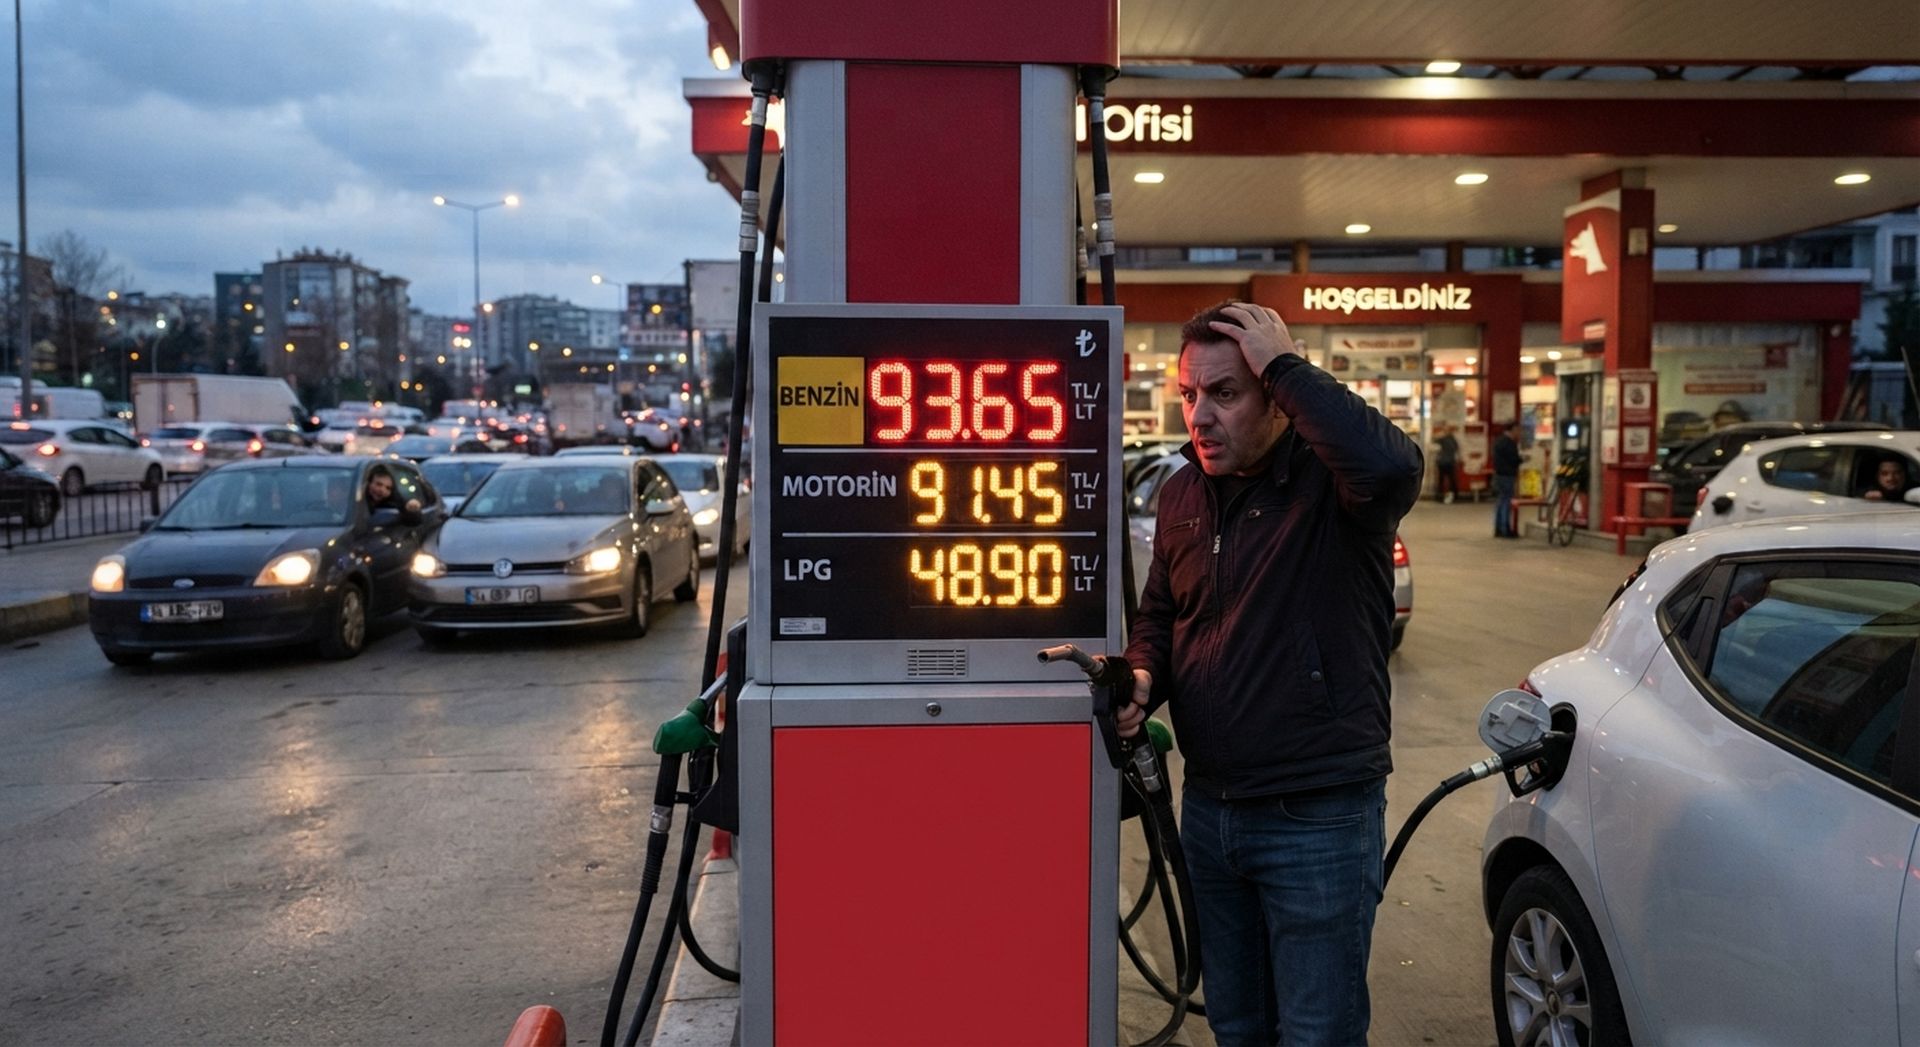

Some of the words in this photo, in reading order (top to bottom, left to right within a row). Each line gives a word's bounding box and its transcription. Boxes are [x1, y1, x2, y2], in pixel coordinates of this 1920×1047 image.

[1103, 105, 1192, 141] Ofisi
[1304, 283, 1471, 314] HOŞGELDİNİZ
[1075, 329, 1097, 357] ₺
[780, 381, 859, 406] BENZİN
[871, 363, 1062, 440] 93.65
[1071, 383, 1100, 399] TL/
[1075, 403, 1096, 420] LT
[783, 471, 896, 497] MOTORİN
[910, 462, 1063, 525] 91.45
[1071, 473, 1099, 489] TL/
[1075, 494, 1095, 510] LT
[784, 559, 831, 581] LPG
[910, 544, 1062, 606] 48.90
[1071, 556, 1099, 571] TL/
[1075, 577, 1094, 592] LT
